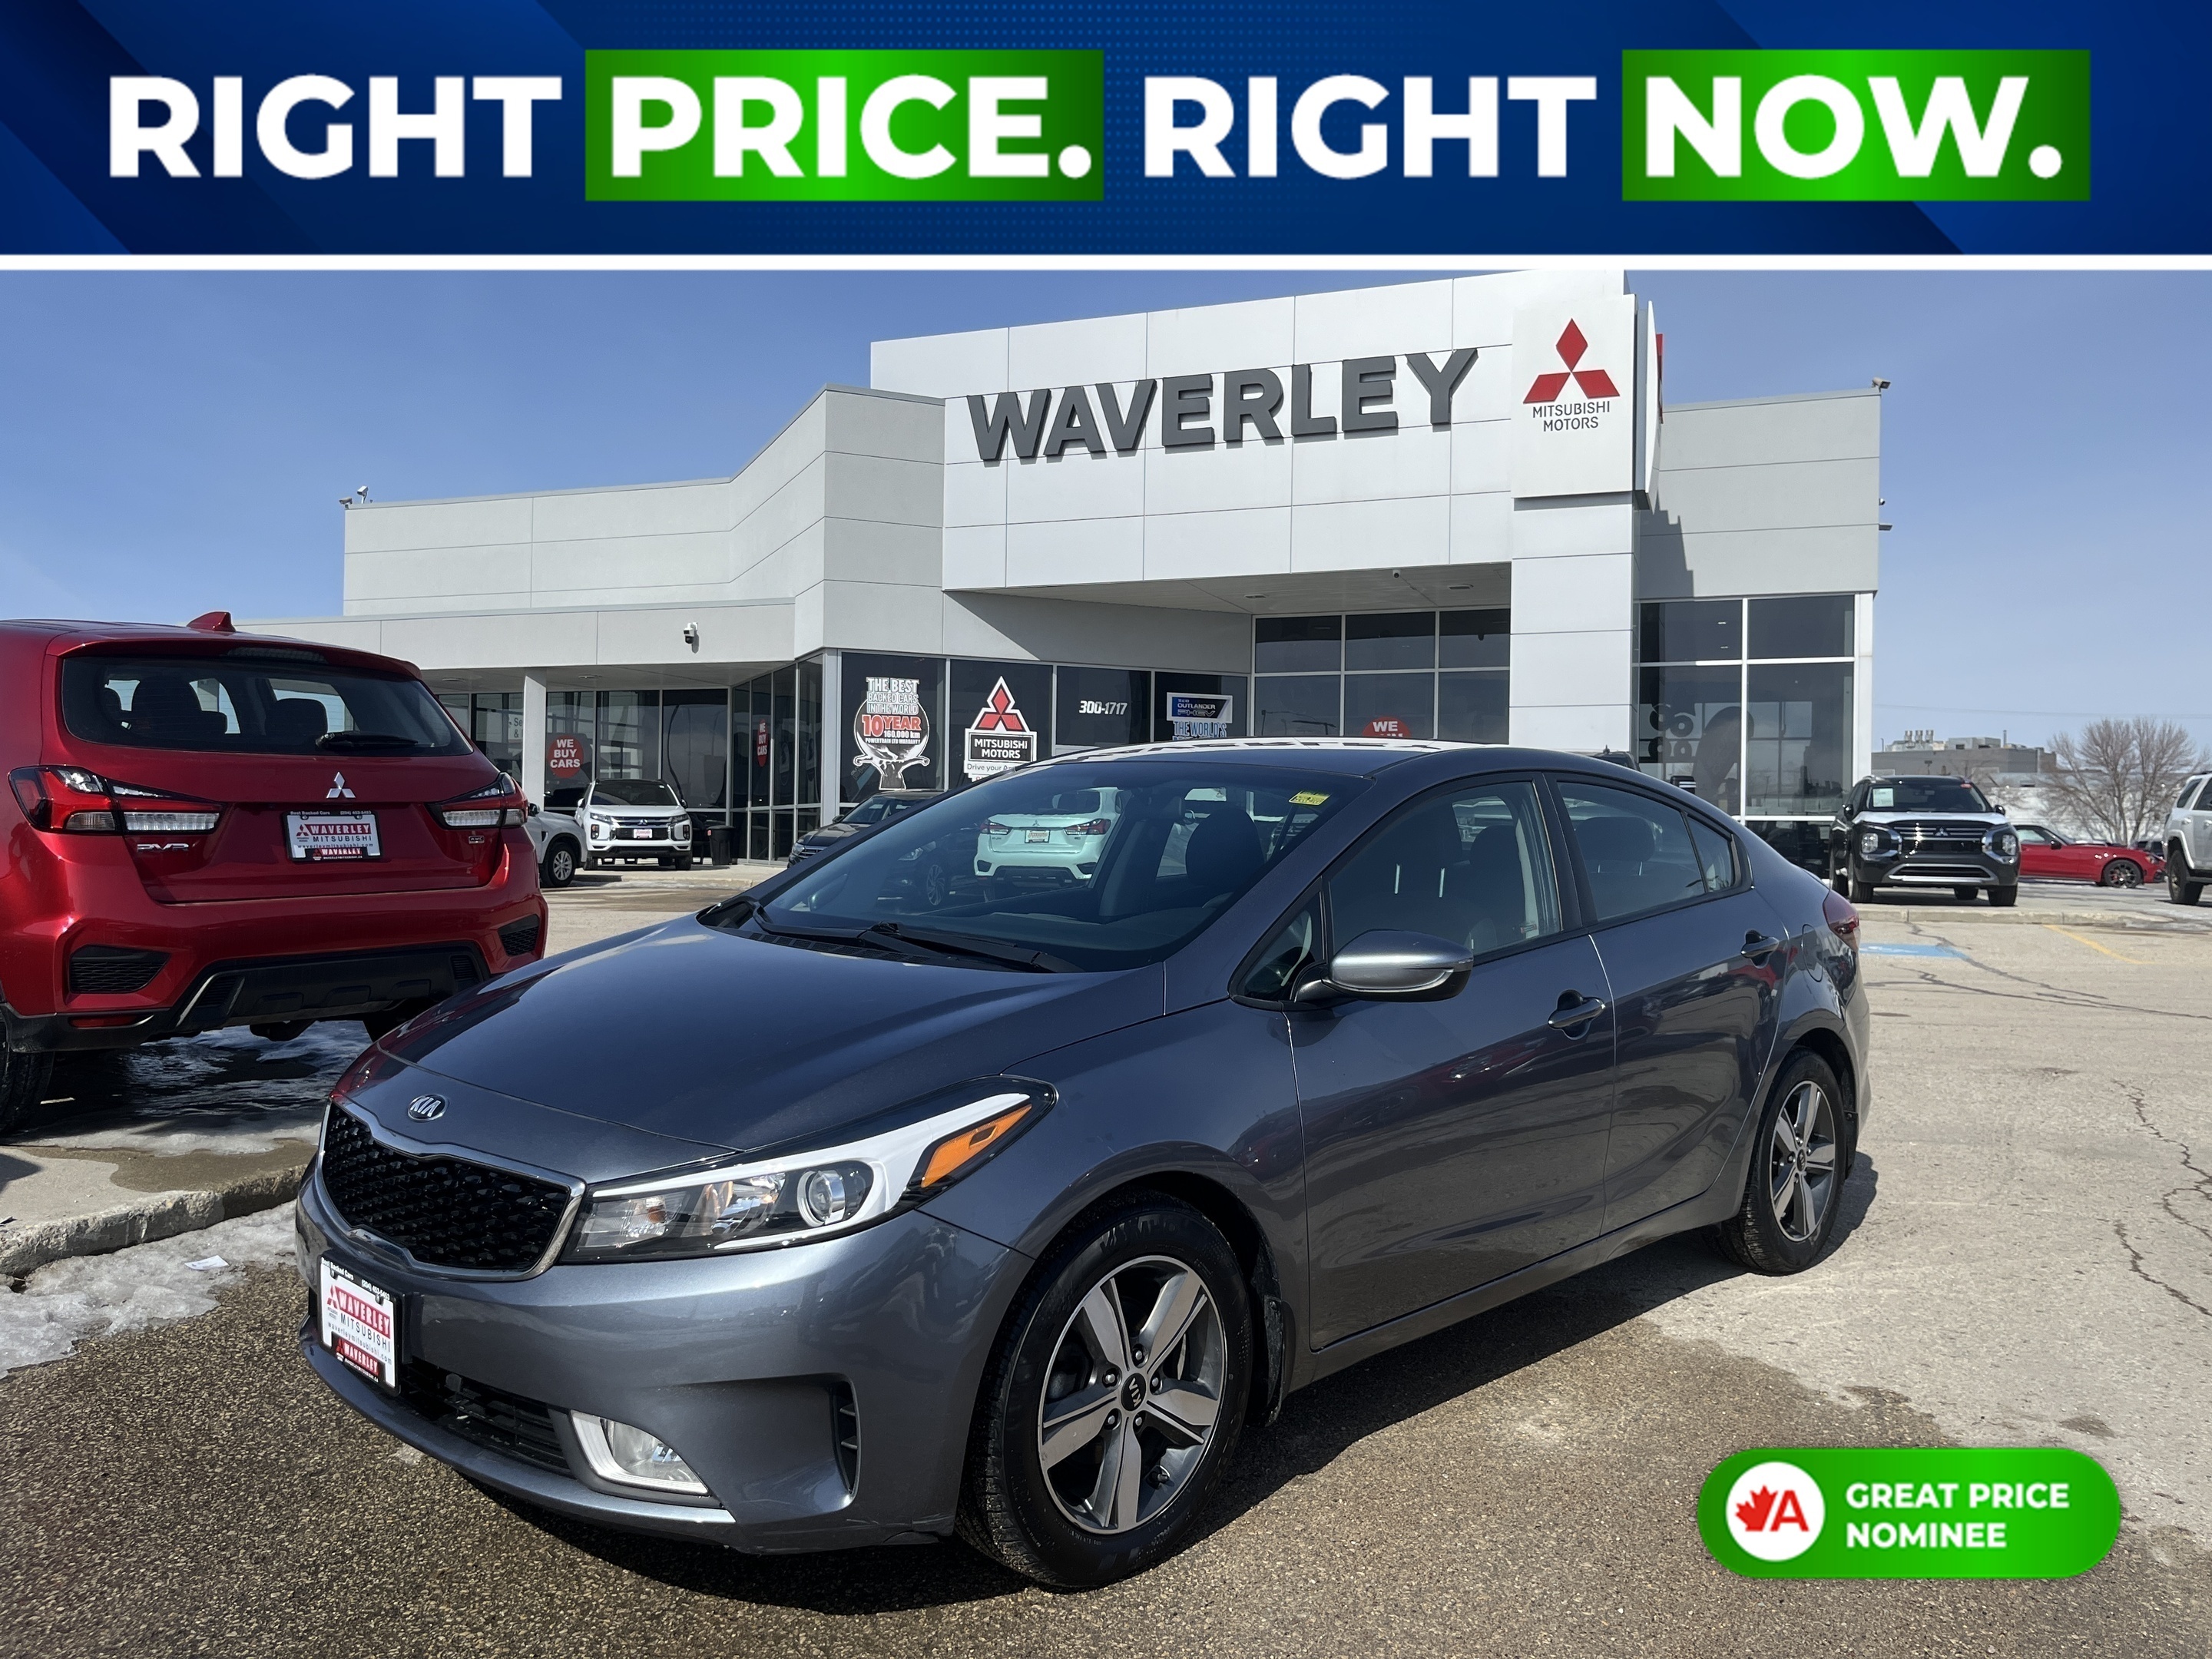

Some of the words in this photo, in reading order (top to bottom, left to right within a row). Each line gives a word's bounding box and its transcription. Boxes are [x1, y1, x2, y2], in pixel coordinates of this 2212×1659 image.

[967, 347, 1479, 462] WAVERLEY
[1533, 401, 1610, 418] MITSUBISHI
[1544, 416, 1598, 432] MOTORS
[866, 677, 889, 692] THE
[890, 678, 919, 694] BEST
[868, 692, 897, 703] BACKED
[868, 703, 875, 713] IN
[876, 703, 890, 714] THE
[891, 704, 918, 714] WORLD
[1079, 700, 1128, 714] 300-1717
[862, 714, 884, 737] 10
[882, 715, 922, 730] YEAR
[1173, 720, 1190, 736] THE
[1373, 721, 1398, 732] WE
[884, 730, 909, 738] 160,000
[557, 739, 574, 747] WE
[974, 738, 1028, 749] MITSUBISHI
[554, 749, 577, 758] BUY
[982, 749, 1021, 758] MOTORS
[550, 759, 581, 768] CARS
[310, 824, 369, 834] WAVERLEY
[409, 1097, 441, 1117] KIA
[338, 1290, 390, 1336] WAVERLEY
[340, 1313, 391, 1353] MITSUBISHI
[343, 1342, 378, 1373] WAVERLEY
[1129, 1377, 1142, 1408] KIA
